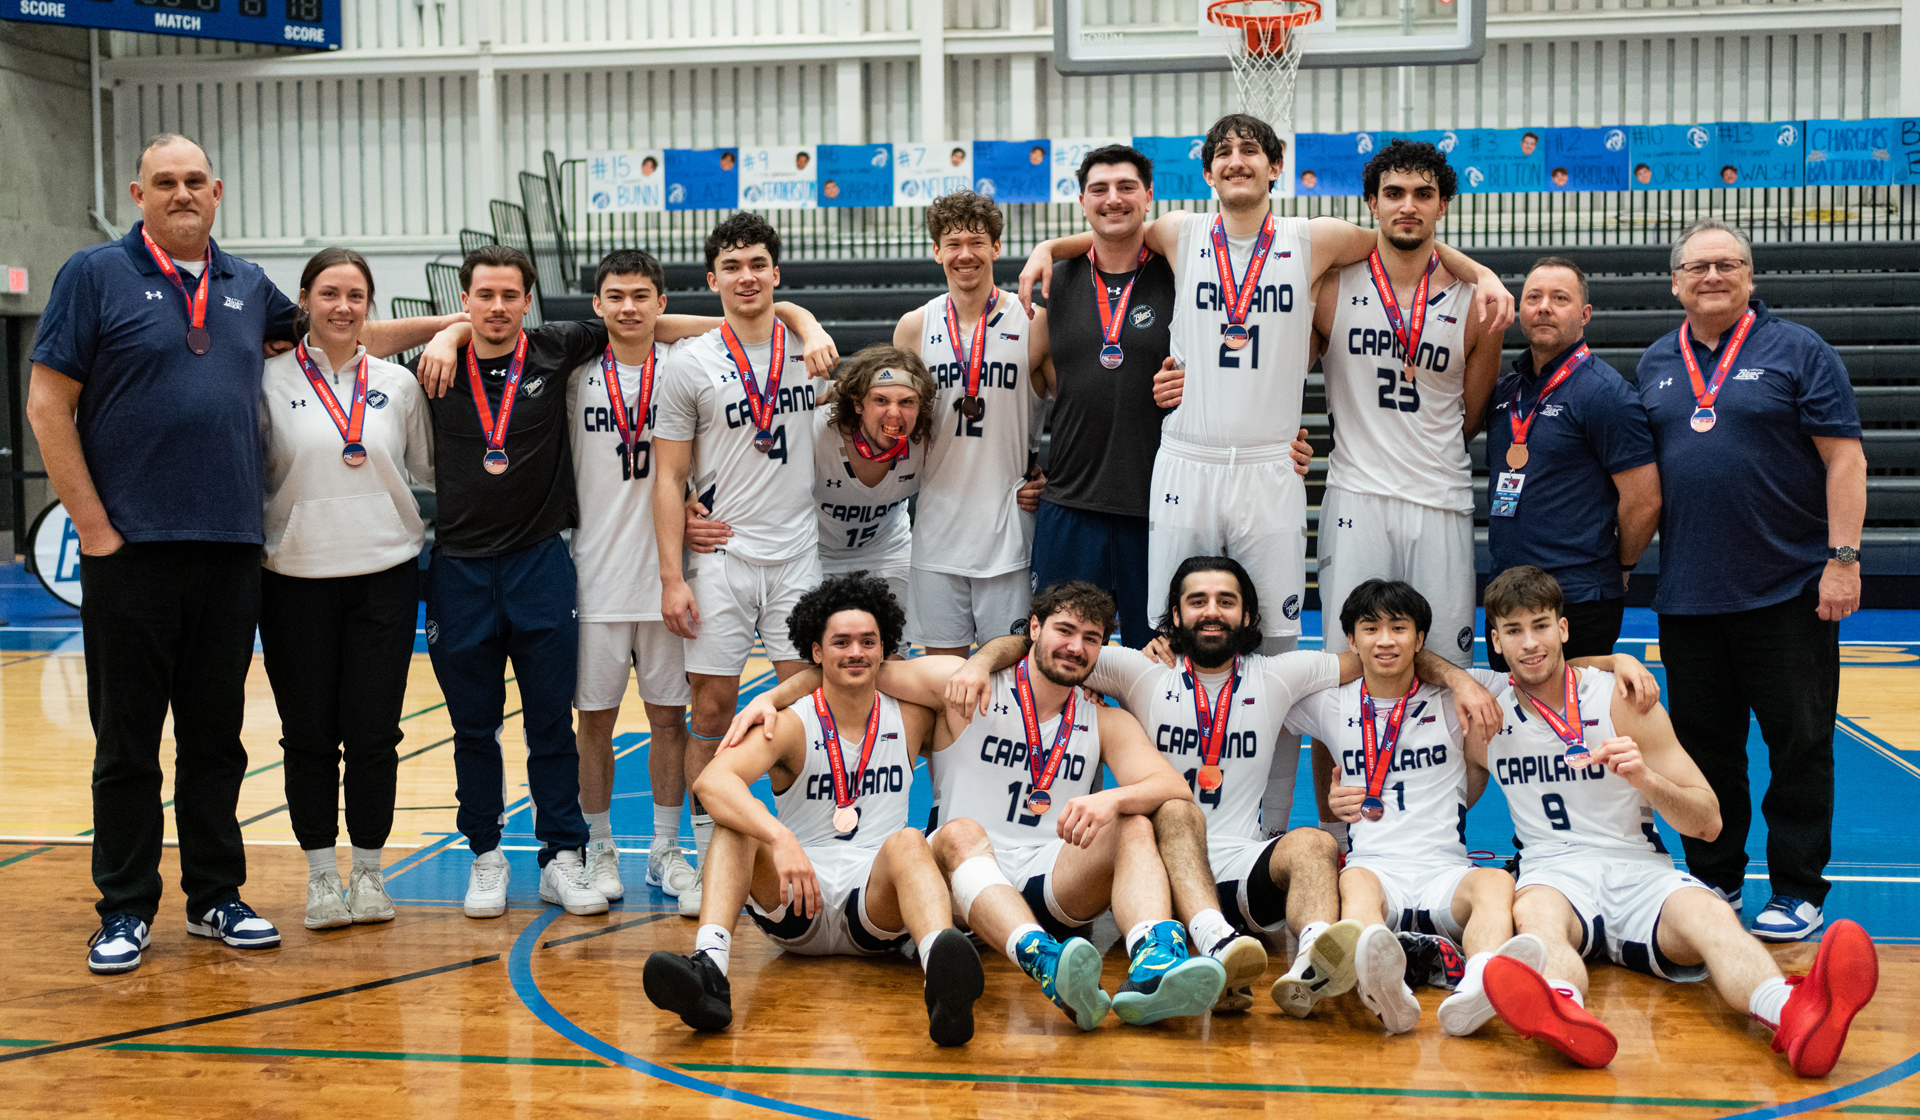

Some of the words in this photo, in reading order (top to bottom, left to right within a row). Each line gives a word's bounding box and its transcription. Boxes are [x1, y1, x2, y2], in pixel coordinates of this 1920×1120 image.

[20, 0, 66, 18] SCORE
[155, 13, 201, 31] MATCH
[284, 25, 325, 43] SCORE
[1081, 33, 1124, 43] FORUM
[1633, 127, 1664, 147] #10
[1719, 123, 1755, 144] #13
[1812, 127, 1889, 151] CHARGERS
[591, 154, 631, 180] #15
[899, 148, 927, 168] #7
[1738, 162, 1796, 182] WALSH
[1807, 158, 1885, 184] BATTALION
[1652, 162, 1709, 185] ORSER
[617, 183, 658, 207] BUNN
[1219, 250, 1229, 279] BASKETBALL
[1225, 280, 1235, 306] 2025-2026
[1238, 283, 1252, 314] BASKETBALL
[1248, 259, 1260, 285] 2025-2026
[1378, 275, 1391, 303] BASKETBALL
[1111, 308, 1123, 337] BASKETBALL
[1218, 323, 1260, 369] 21
[1722, 339, 1740, 368] BASKETBALL
[317, 382, 335, 409] BASKETBALL
[1377, 367, 1421, 413] 23
[496, 411, 508, 441] BASKETBALL
[503, 385, 514, 411] 2025-2026
[953, 397, 985, 438] 12
[768, 425, 787, 464] 4
[615, 441, 651, 481] 10
[846, 523, 880, 547] 15
[1021, 684, 1032, 716] BASKETBALL
[1027, 716, 1038, 743] 2025-2026
[1366, 724, 1374, 756] BASKETBALL
[830, 742, 841, 770] 2025-2026
[837, 770, 846, 803] BASKETBALL
[1391, 781, 1405, 811] 1
[1541, 793, 1571, 830] 9
